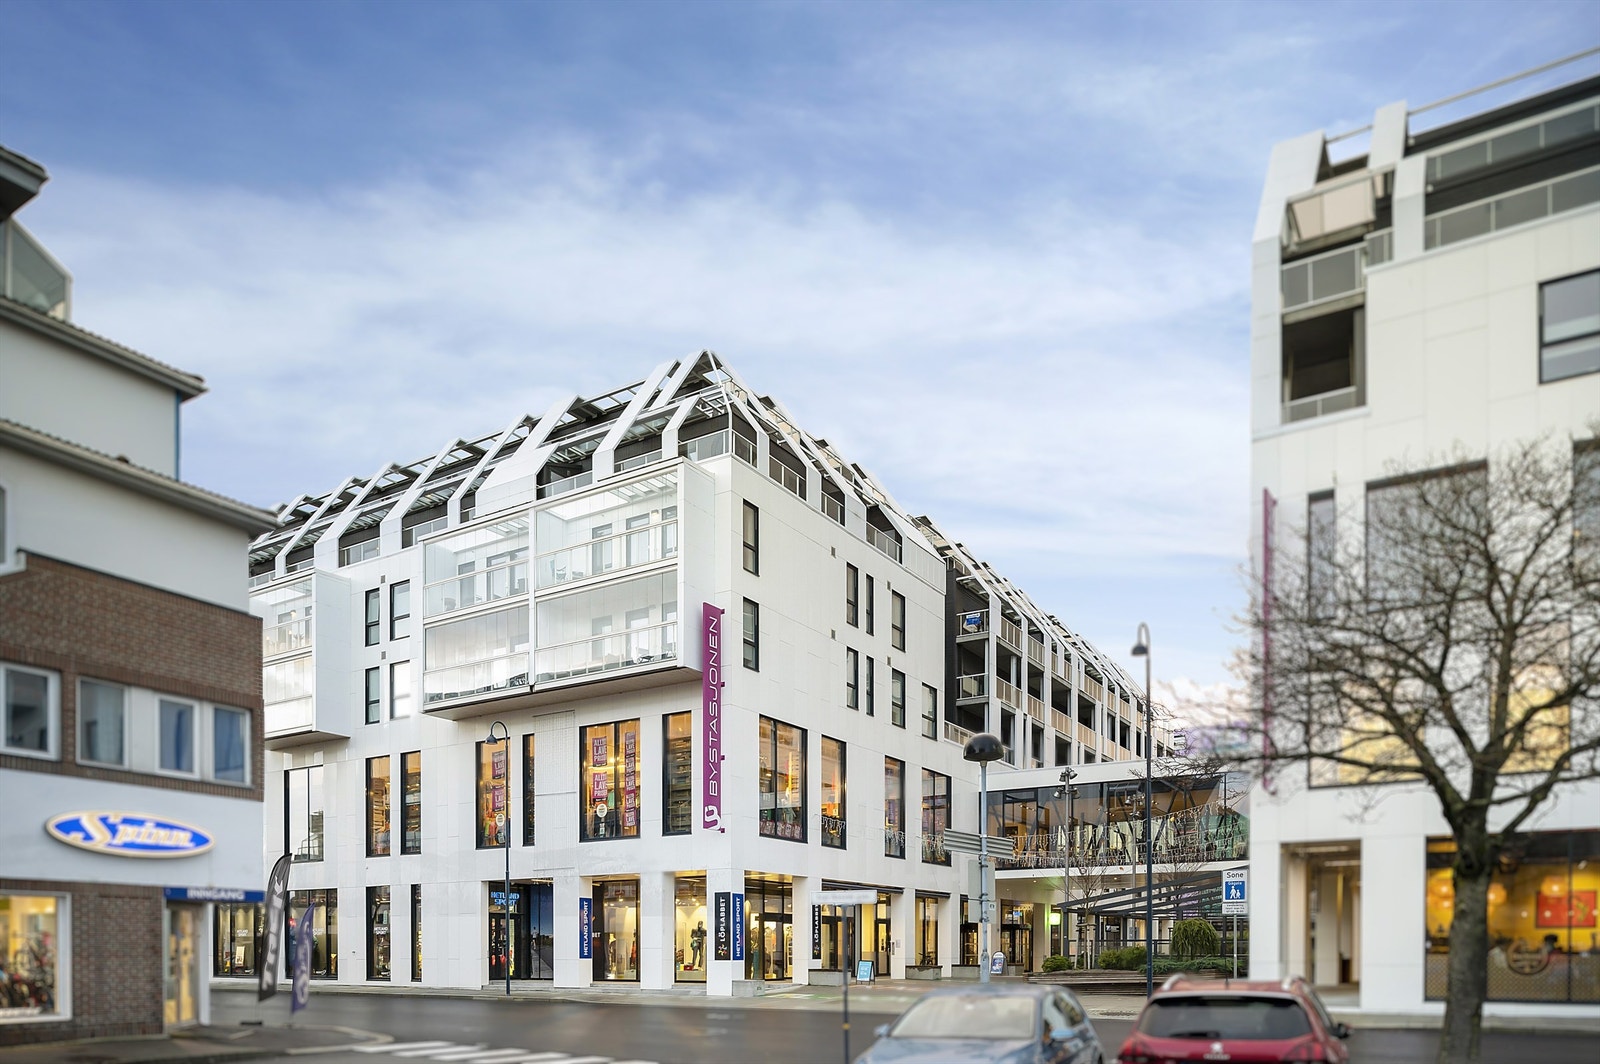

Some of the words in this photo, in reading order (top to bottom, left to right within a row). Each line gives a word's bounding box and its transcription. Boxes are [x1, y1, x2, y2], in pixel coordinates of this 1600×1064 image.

[709, 616, 718, 796] BYSTASJONEN
[187, 888, 245, 899] INNGANG
[490, 891, 519, 899] HETLND
[718, 897, 726, 942] LÖPLABBET
